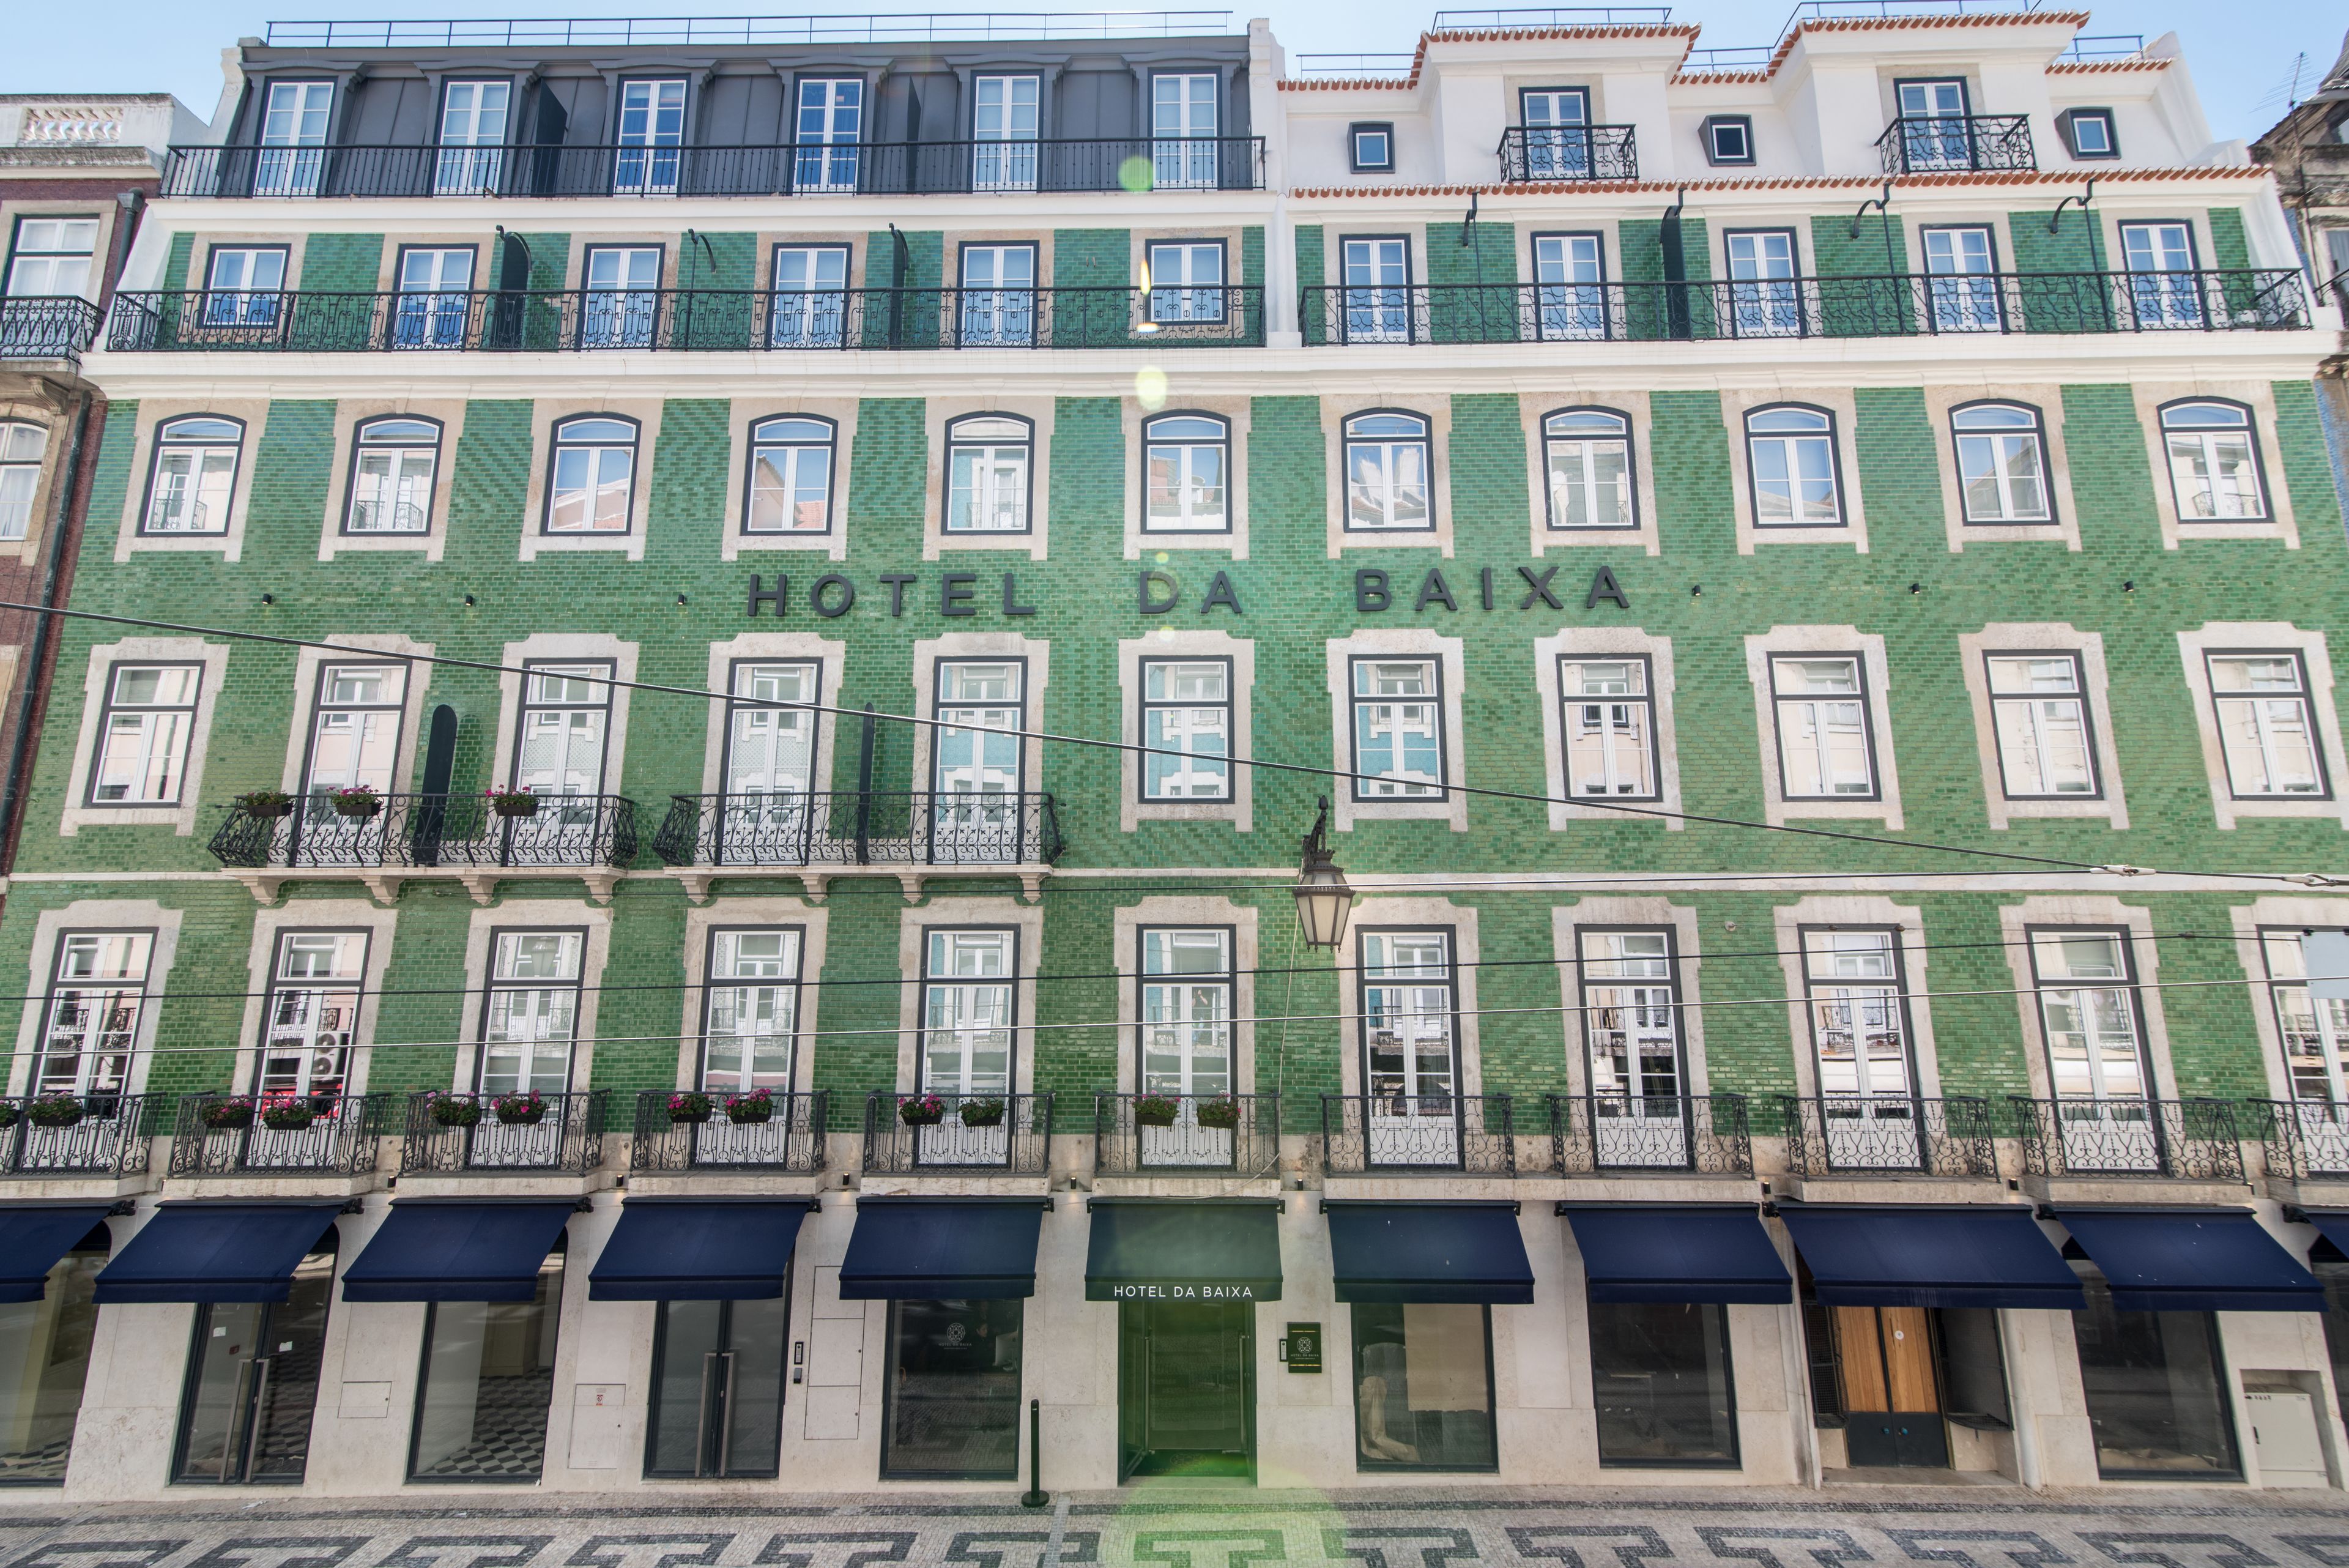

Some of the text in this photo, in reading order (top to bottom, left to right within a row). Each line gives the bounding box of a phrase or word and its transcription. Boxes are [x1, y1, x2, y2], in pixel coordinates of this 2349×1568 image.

[747, 565, 1631, 618] HOTEL DA BAIXA
[1114, 1285, 1253, 1298] HOTEL DA BAIXA
